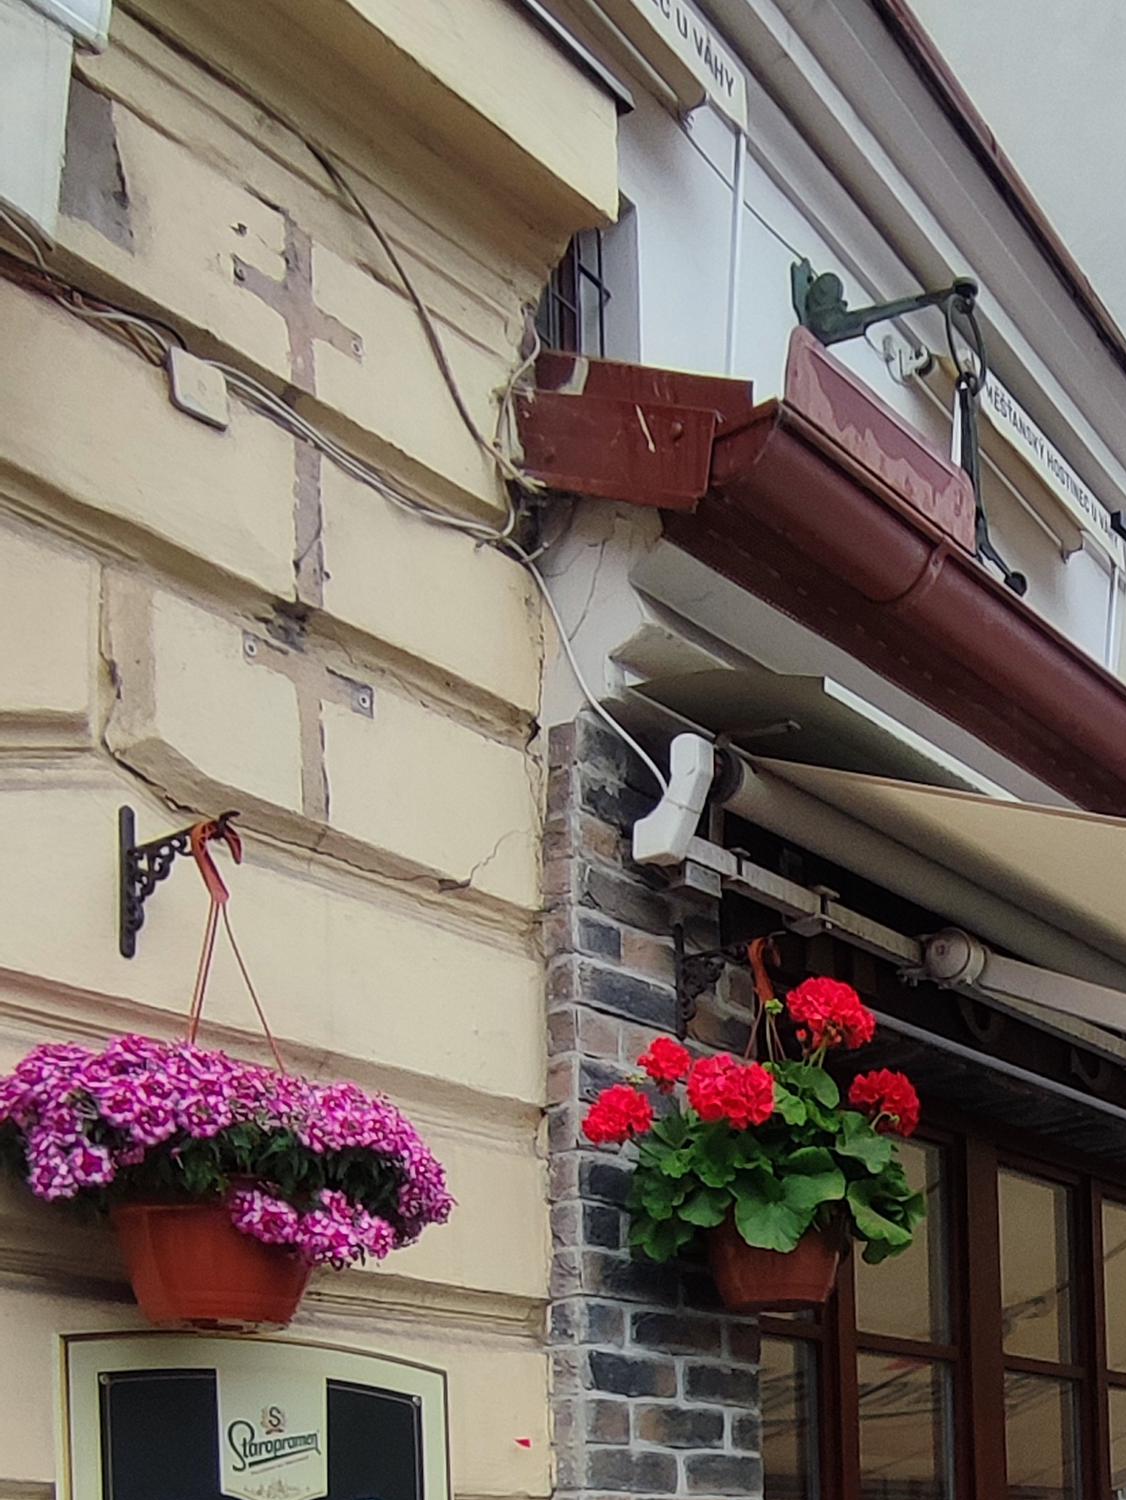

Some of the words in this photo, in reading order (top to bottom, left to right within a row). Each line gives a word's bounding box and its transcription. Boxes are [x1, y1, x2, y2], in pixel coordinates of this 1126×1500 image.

[676, 8, 687, 39] U
[693, 28, 734, 97] VÁHY
[228, 1420, 321, 1472] Staropramen
